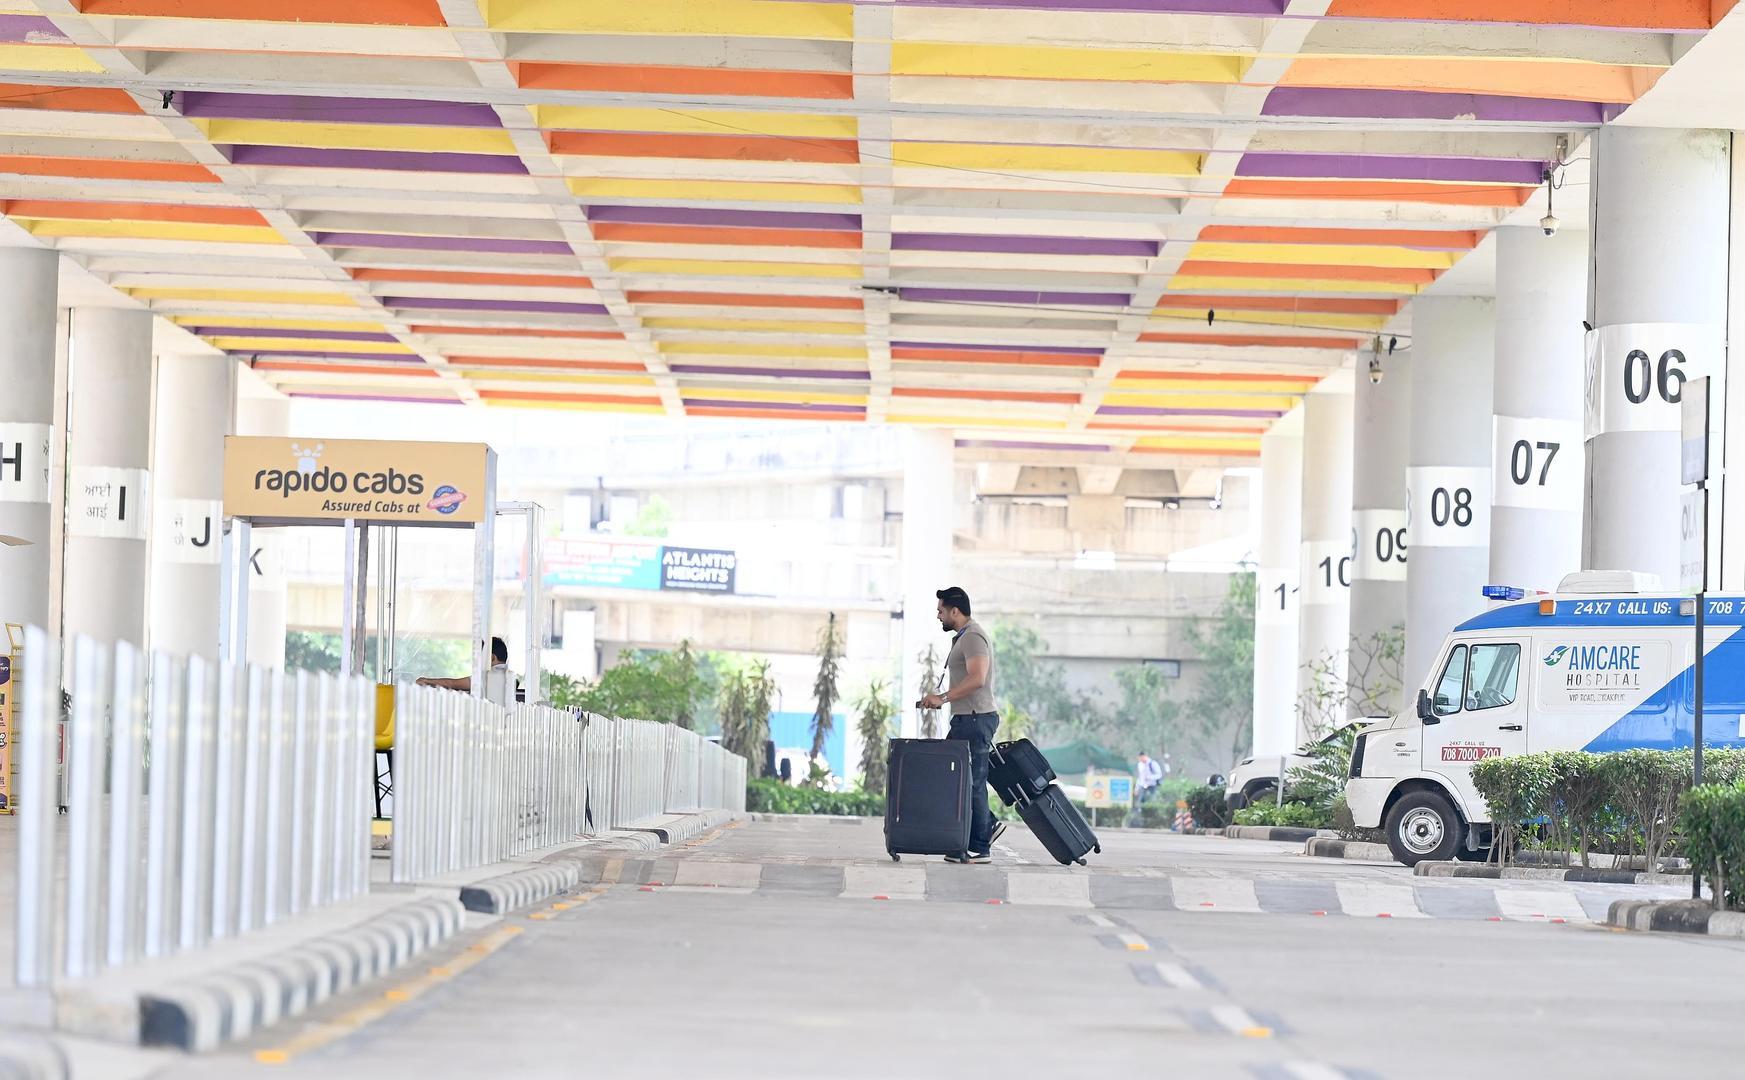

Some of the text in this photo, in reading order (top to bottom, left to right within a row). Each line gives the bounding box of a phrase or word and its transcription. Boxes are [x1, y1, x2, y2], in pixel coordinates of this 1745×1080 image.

[1623, 348, 1687, 404] 06
[0, 442, 22, 481] H
[1510, 439, 1561, 487] 07
[254, 465, 424, 498] rapido cabs
[118, 485, 126, 520] I
[321, 499, 421, 514] Assured Cabs at
[1430, 486, 1474, 528] 08
[191, 516, 211, 547] J
[1376, 527, 1407, 563] 09
[662, 551, 736, 570] ATLANTIS
[666, 566, 729, 583] HEIGHTS
[1318, 556, 1351, 587] 10
[1573, 602, 1612, 615] 24X7
[1617, 602, 1649, 615] CALL
[1653, 602, 1672, 614] US:
[1708, 601, 1733, 614] 708
[1568, 645, 1641, 670] AMCARE
[1566, 673, 1640, 686] HOSPITAL
[1443, 748, 1456, 760] 708
